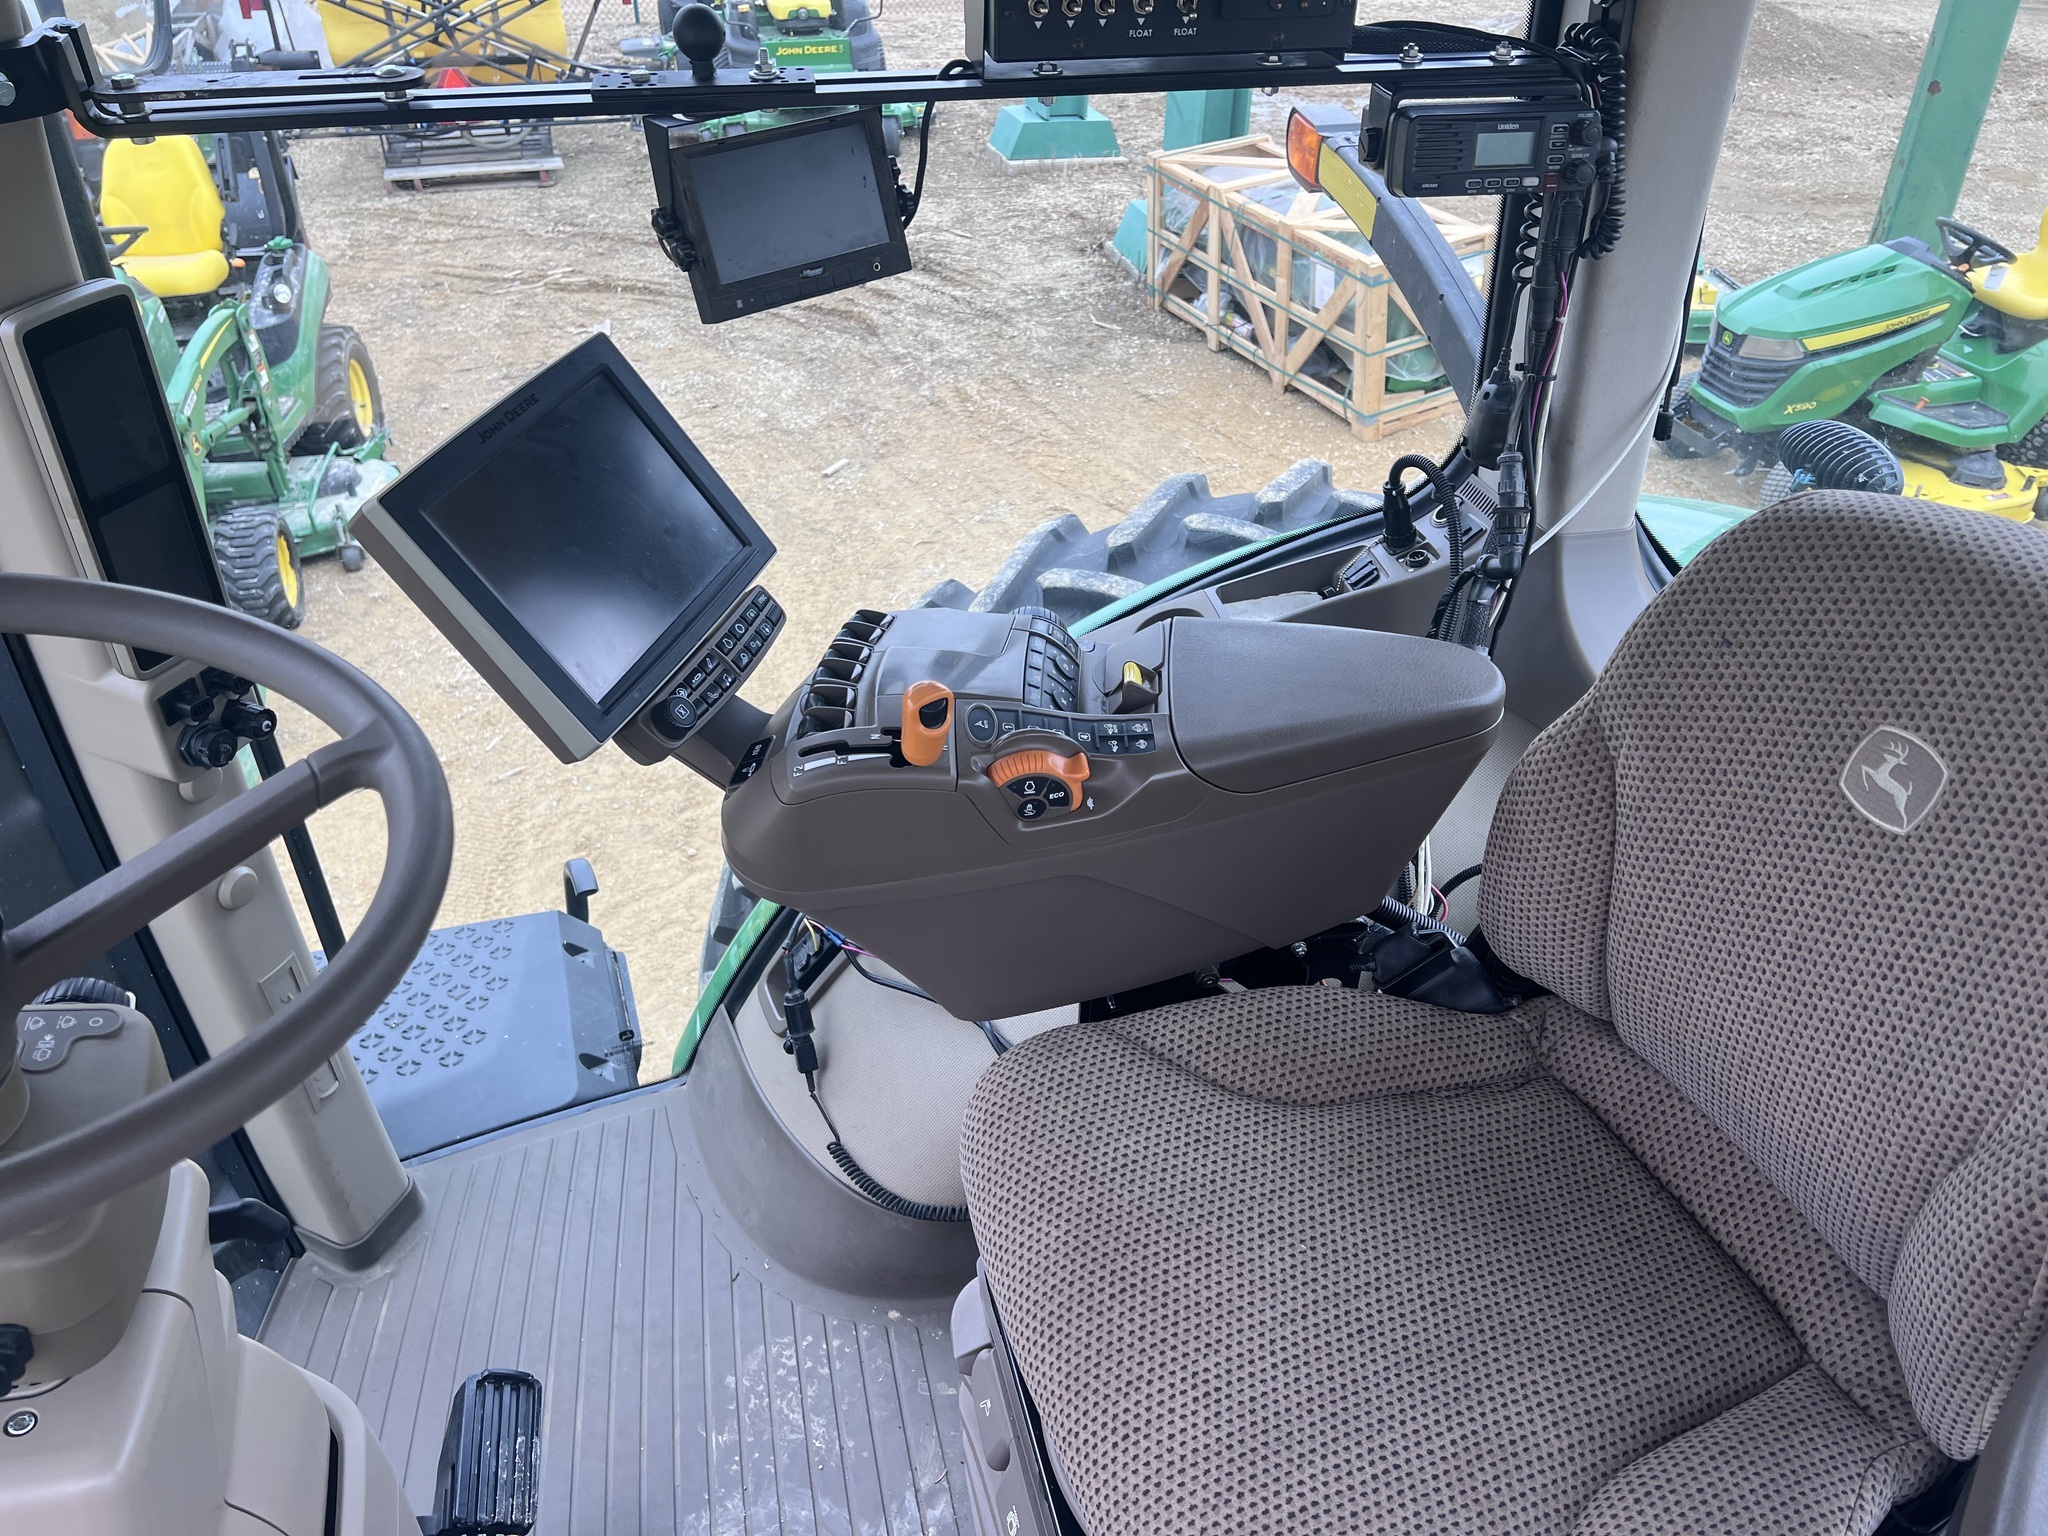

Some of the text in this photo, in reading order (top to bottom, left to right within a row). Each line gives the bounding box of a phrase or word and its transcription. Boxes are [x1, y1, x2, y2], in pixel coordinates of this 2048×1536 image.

[1129, 29, 1153, 38] FLOAT
[1173, 28, 1198, 36] FLOAT
[776, 45, 838, 56] JOHN DEERE
[1497, 123, 1519, 131] Uniden
[1883, 310, 1932, 331] JOHN DEERE
[1783, 401, 1817, 415] X590
[478, 393, 540, 445] JOHN DEERE
[836, 755, 848, 765] F1
[793, 764, 804, 777] F2
[1049, 791, 1065, 800] ECO
